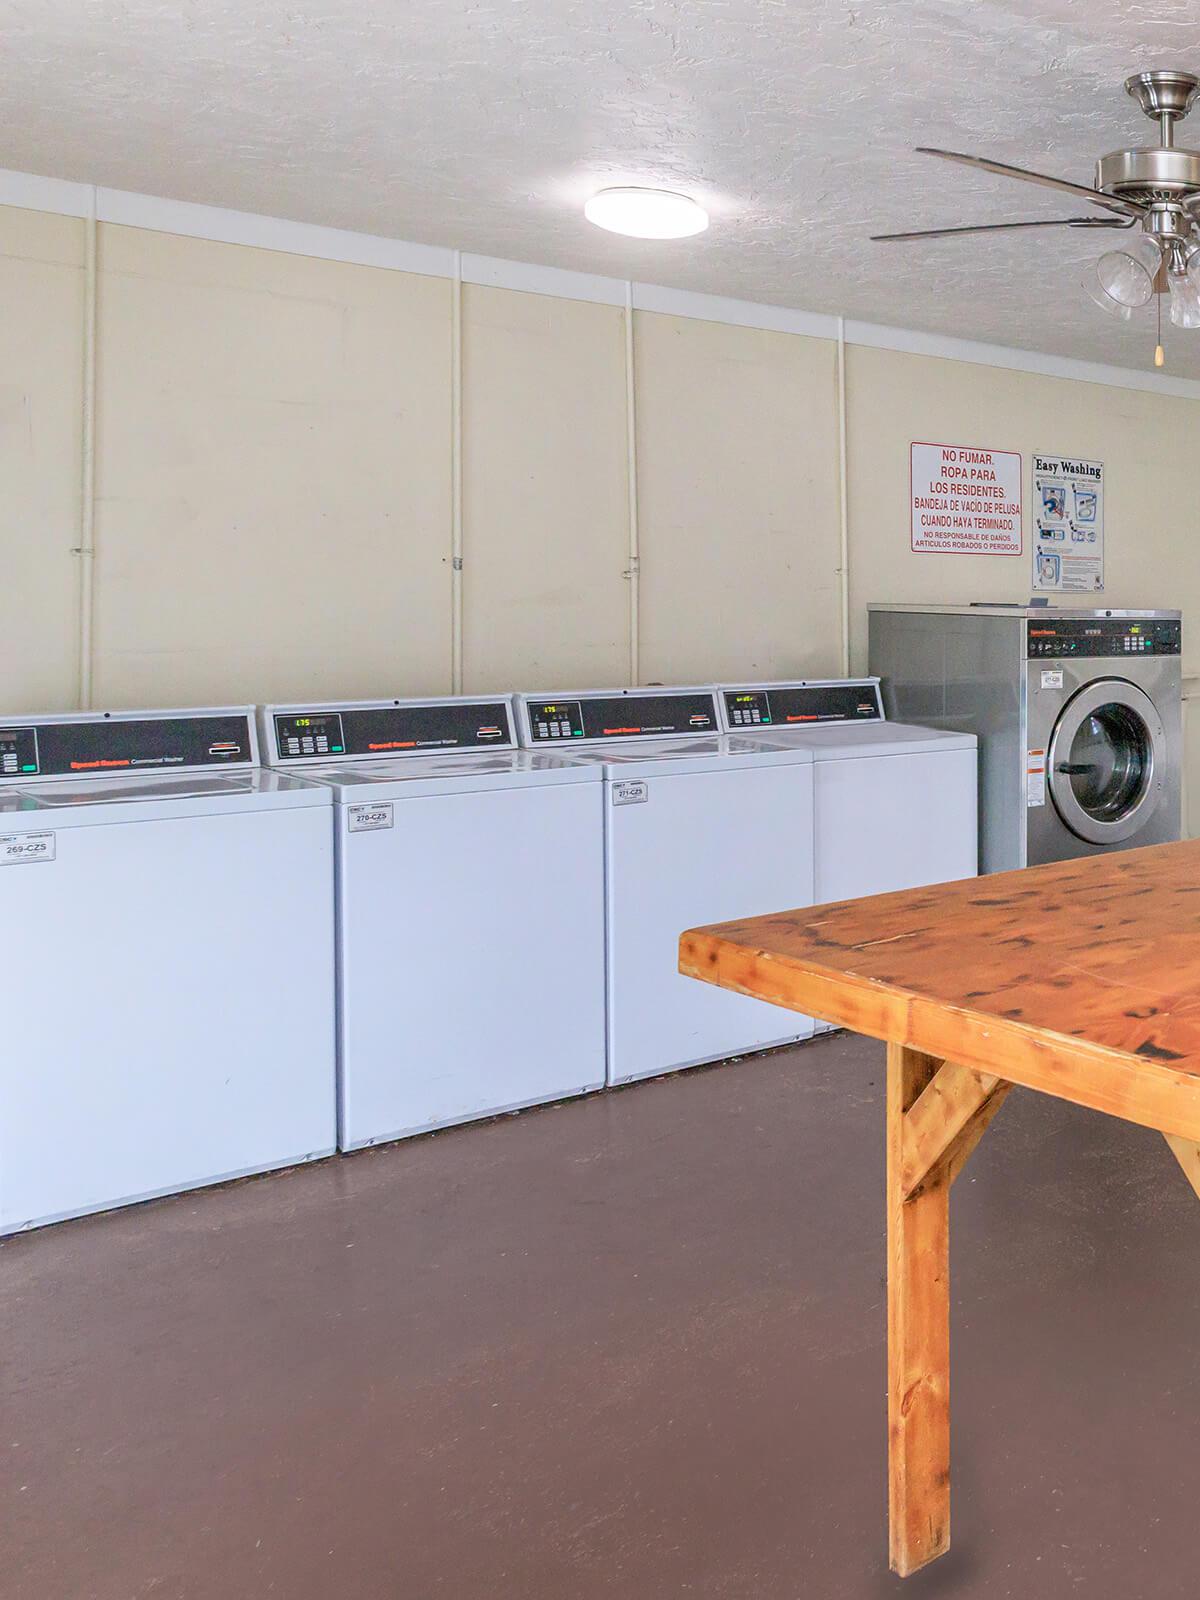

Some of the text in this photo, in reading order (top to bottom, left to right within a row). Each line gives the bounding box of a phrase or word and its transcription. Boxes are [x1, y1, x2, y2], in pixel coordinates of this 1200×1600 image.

[942, 449, 995, 466] NO FUMAR.
[940, 466, 997, 482] ROPA PARA
[1035, 458, 1059, 475] Easy
[1060, 461, 1102, 480] Washing
[929, 481, 1007, 498] LOS RESIDENTES.
[914, 497, 949, 511] BANDEJA
[949, 499, 960, 511] DE
[983, 502, 993, 514] DE
[994, 502, 1020, 515] PELUSA
[920, 514, 1015, 531] CUANDO HAYA TERMINADO.
[923, 531, 934, 539] NO
[934, 532, 980, 541] RESPONSABLE
[952, 541, 982, 550] ROBADOS
[983, 542, 989, 550] O
[989, 543, 1019, 551] PERDIDOS
[6, 843, 47, 854] 269-CZS
